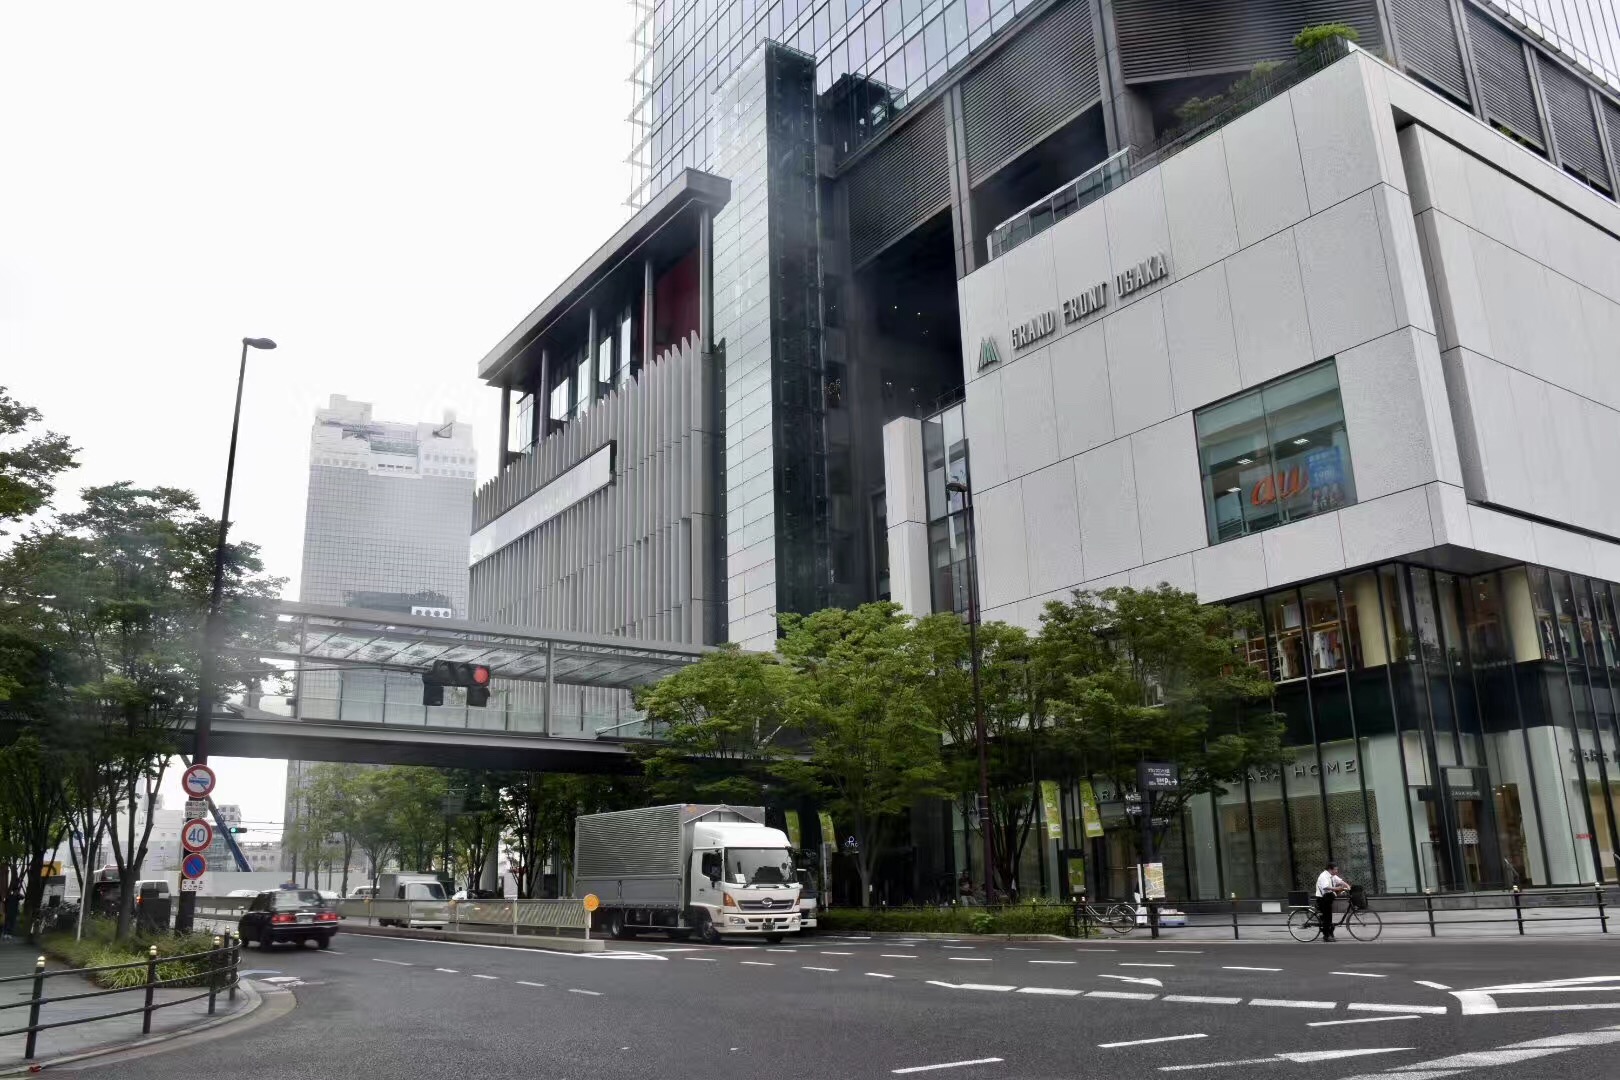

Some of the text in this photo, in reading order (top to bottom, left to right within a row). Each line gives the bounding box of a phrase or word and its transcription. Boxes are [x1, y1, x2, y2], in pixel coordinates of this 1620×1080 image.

[1012, 252, 1169, 350] GRAND FRONT OSAKA
[1252, 465, 1309, 505] au
[1294, 760, 1357, 777] HOME
[188, 828, 205, 843] 40
